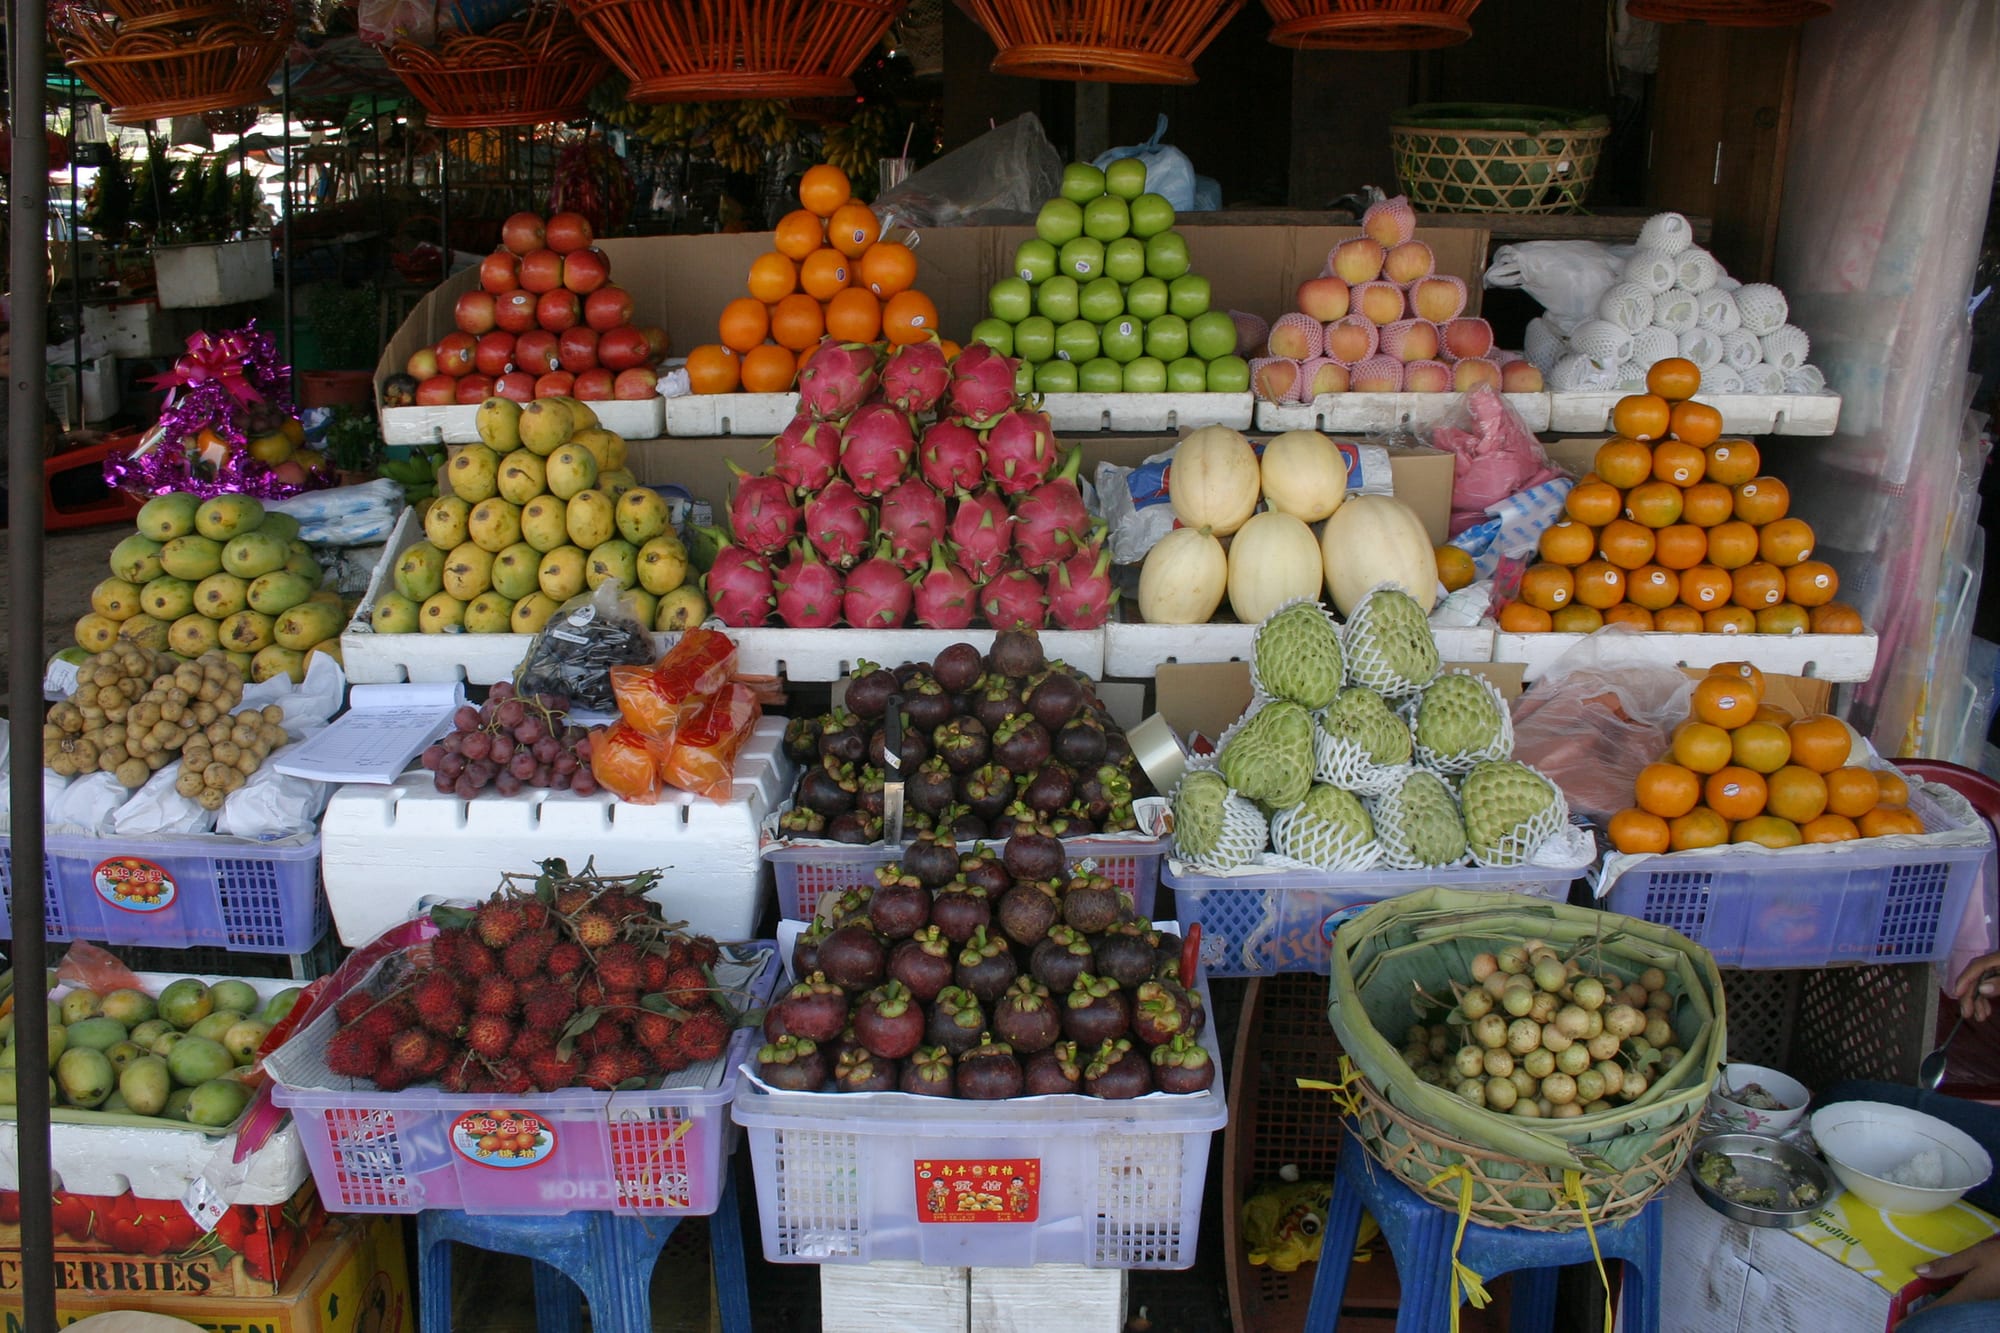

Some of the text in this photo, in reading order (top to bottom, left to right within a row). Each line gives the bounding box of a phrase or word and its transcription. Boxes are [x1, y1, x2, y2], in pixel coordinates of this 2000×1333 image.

[101, 866, 163, 883] 中华名果
[460, 1118, 540, 1134] 中华名果
[0, 1260, 211, 1291] CERRIES
